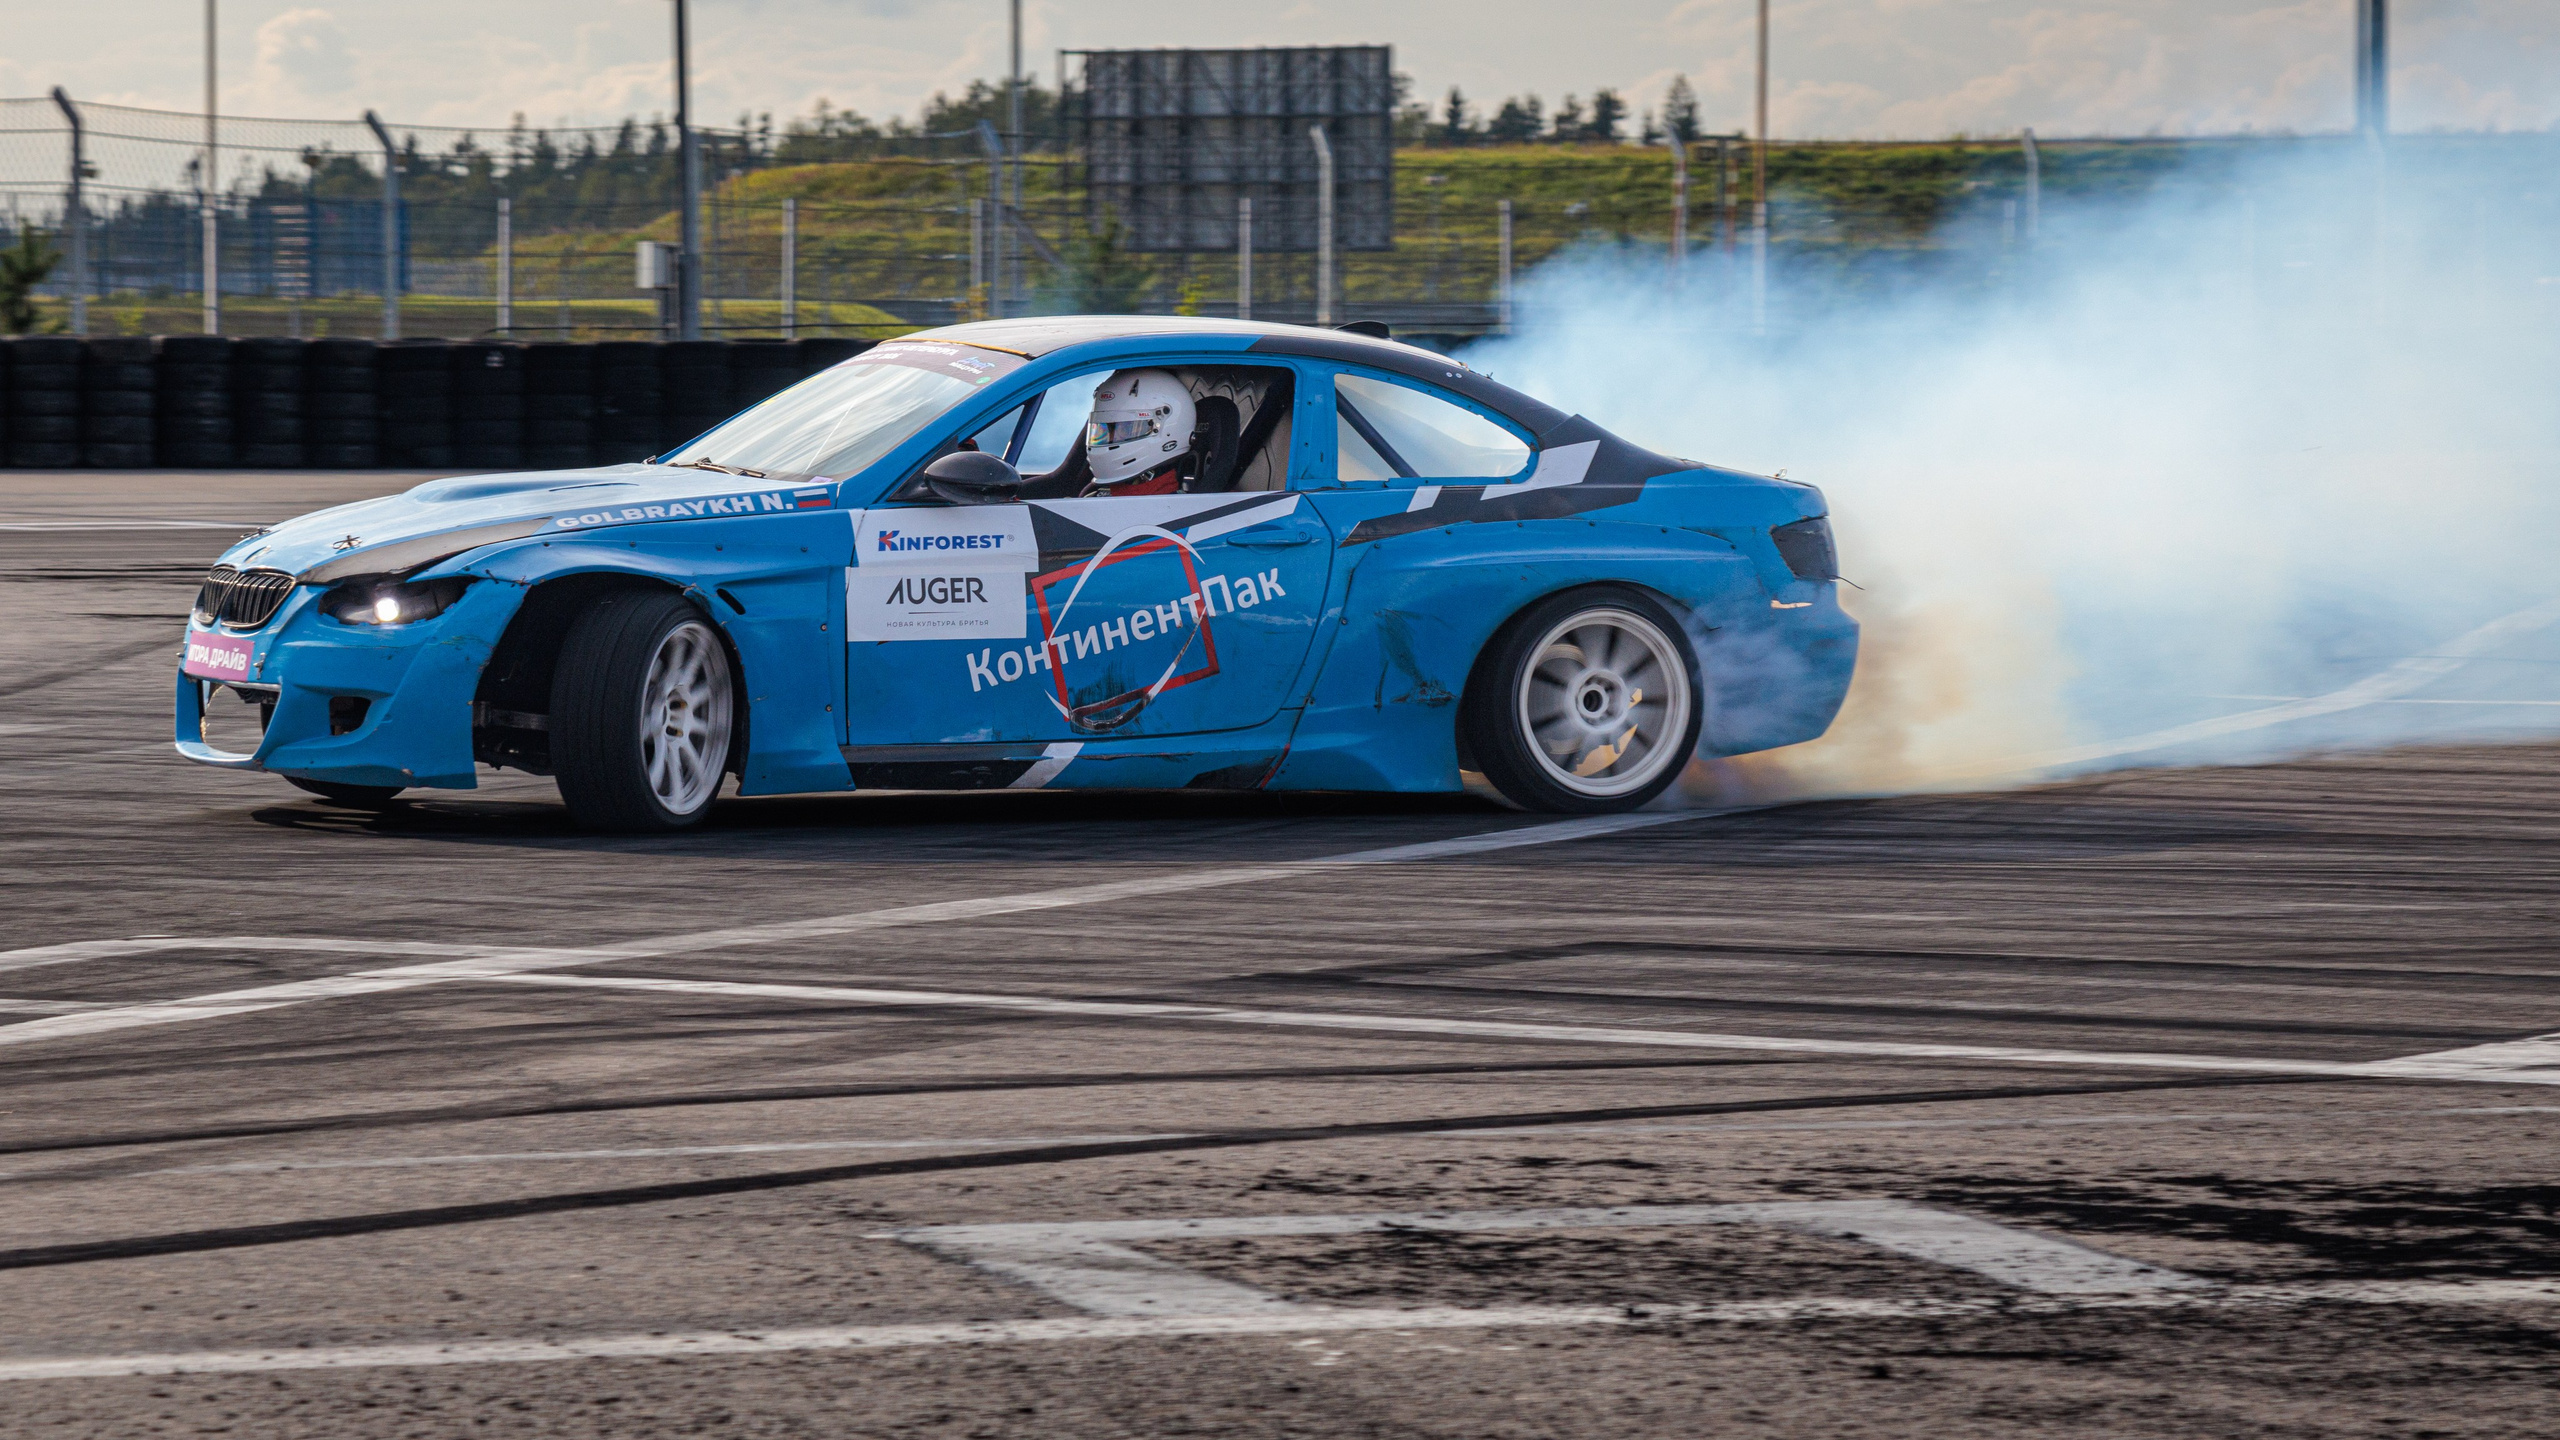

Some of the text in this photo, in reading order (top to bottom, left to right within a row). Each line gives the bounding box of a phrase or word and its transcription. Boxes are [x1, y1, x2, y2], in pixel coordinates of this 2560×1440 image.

[556, 493, 794, 528] GOLBRAYKH N.
[878, 530, 1004, 551] KINFOREST
[886, 577, 988, 604] AUGER
[966, 567, 1287, 692] КонтинентПак
[208, 647, 248, 671] ДРАЙВ
